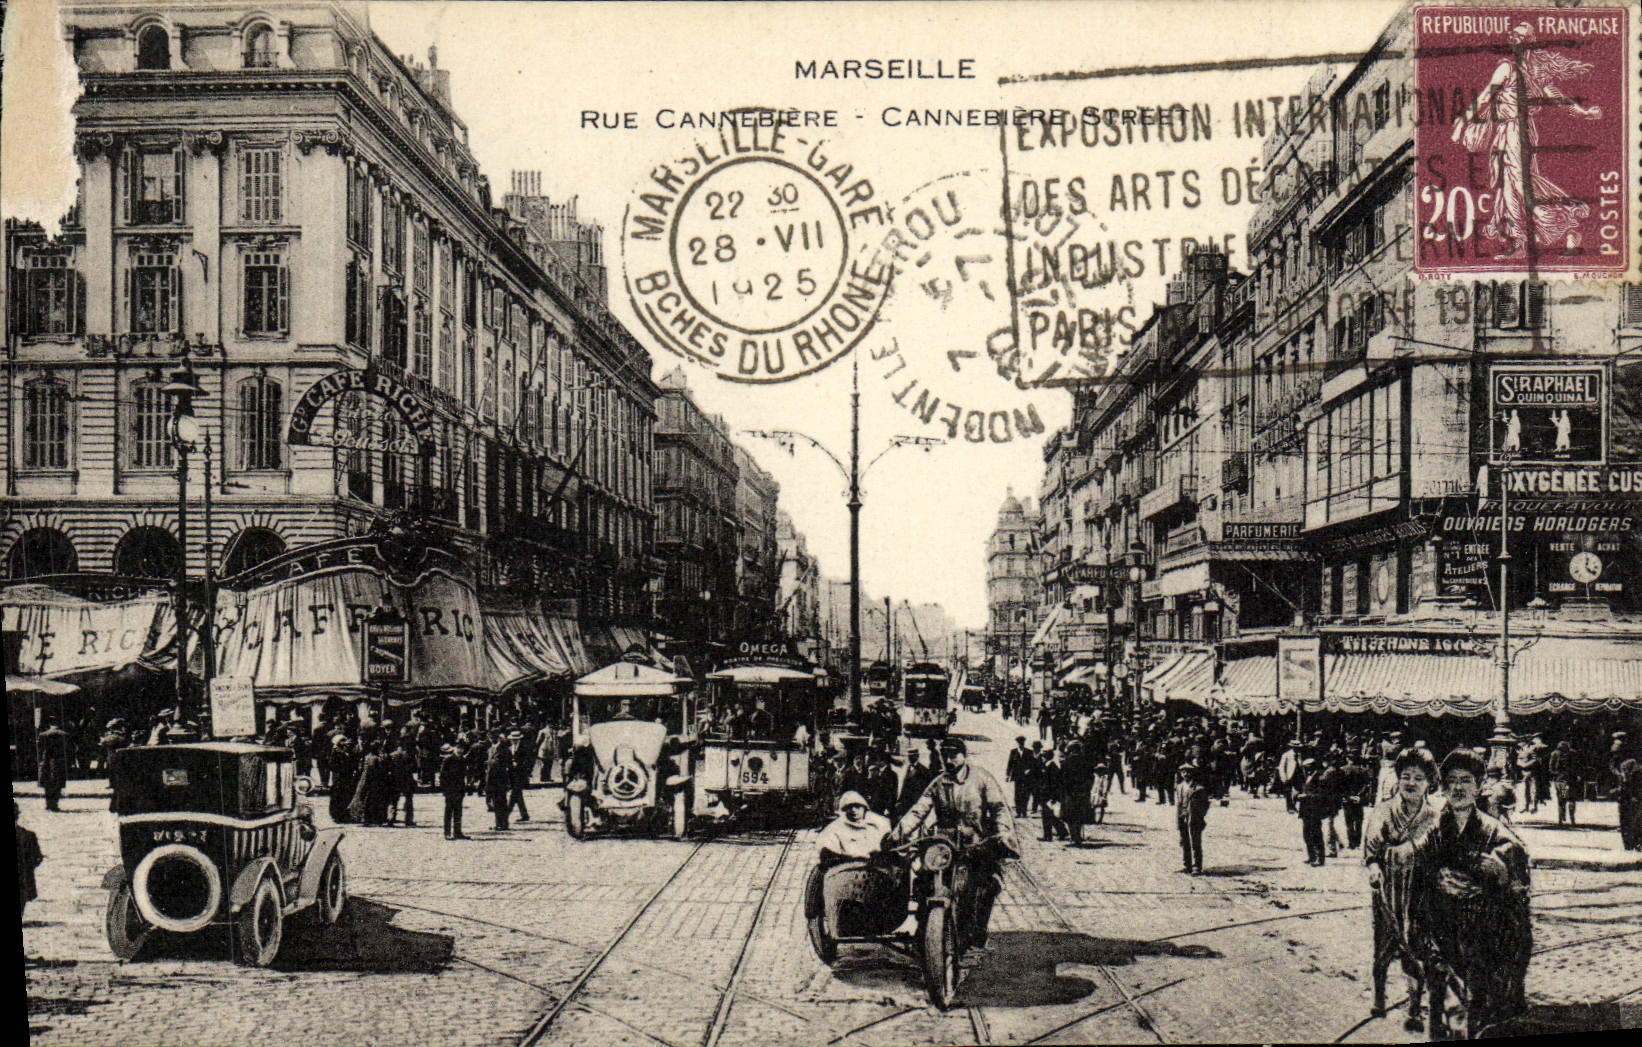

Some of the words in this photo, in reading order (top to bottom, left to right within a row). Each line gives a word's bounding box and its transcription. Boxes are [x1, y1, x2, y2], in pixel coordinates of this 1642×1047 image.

[1538, 16, 1619, 36] FRANÇAISE
[1600, 170, 1619, 255] POSTES
[1517, 392, 1582, 404] QUINQUINA
[1225, 525, 1299, 538] PARFUMERIE
[1443, 516, 1526, 532] OUVRIERS
[1533, 516, 1633, 532] HORLOGERS
[1444, 561, 1489, 575] ATELIERS
[740, 641, 788, 656] OMEGA
